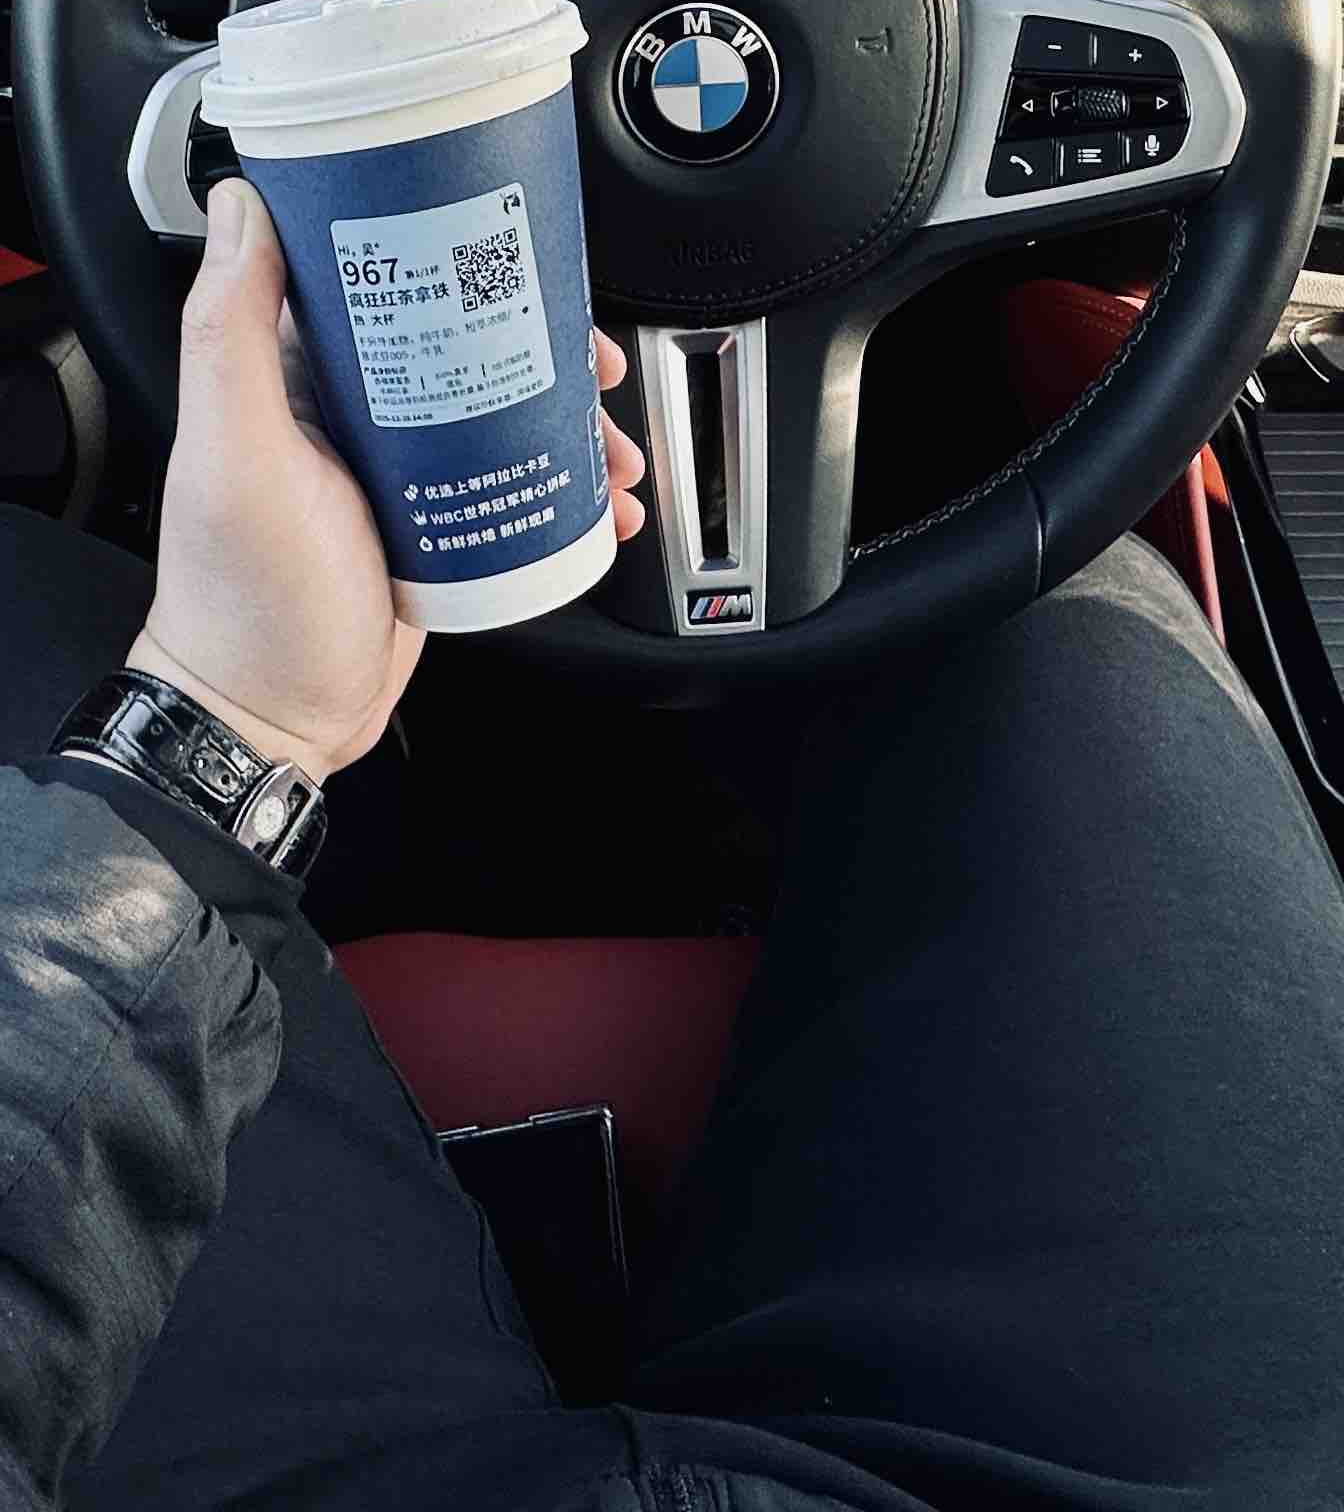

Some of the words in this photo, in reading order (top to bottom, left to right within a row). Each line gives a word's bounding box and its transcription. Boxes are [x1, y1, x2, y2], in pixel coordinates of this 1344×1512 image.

[635, 11, 763, 64] BMW
[342, 257, 399, 286] 967
[348, 280, 450, 309] 疯狂红茶拿铁
[371, 313, 395, 327] 大杯
